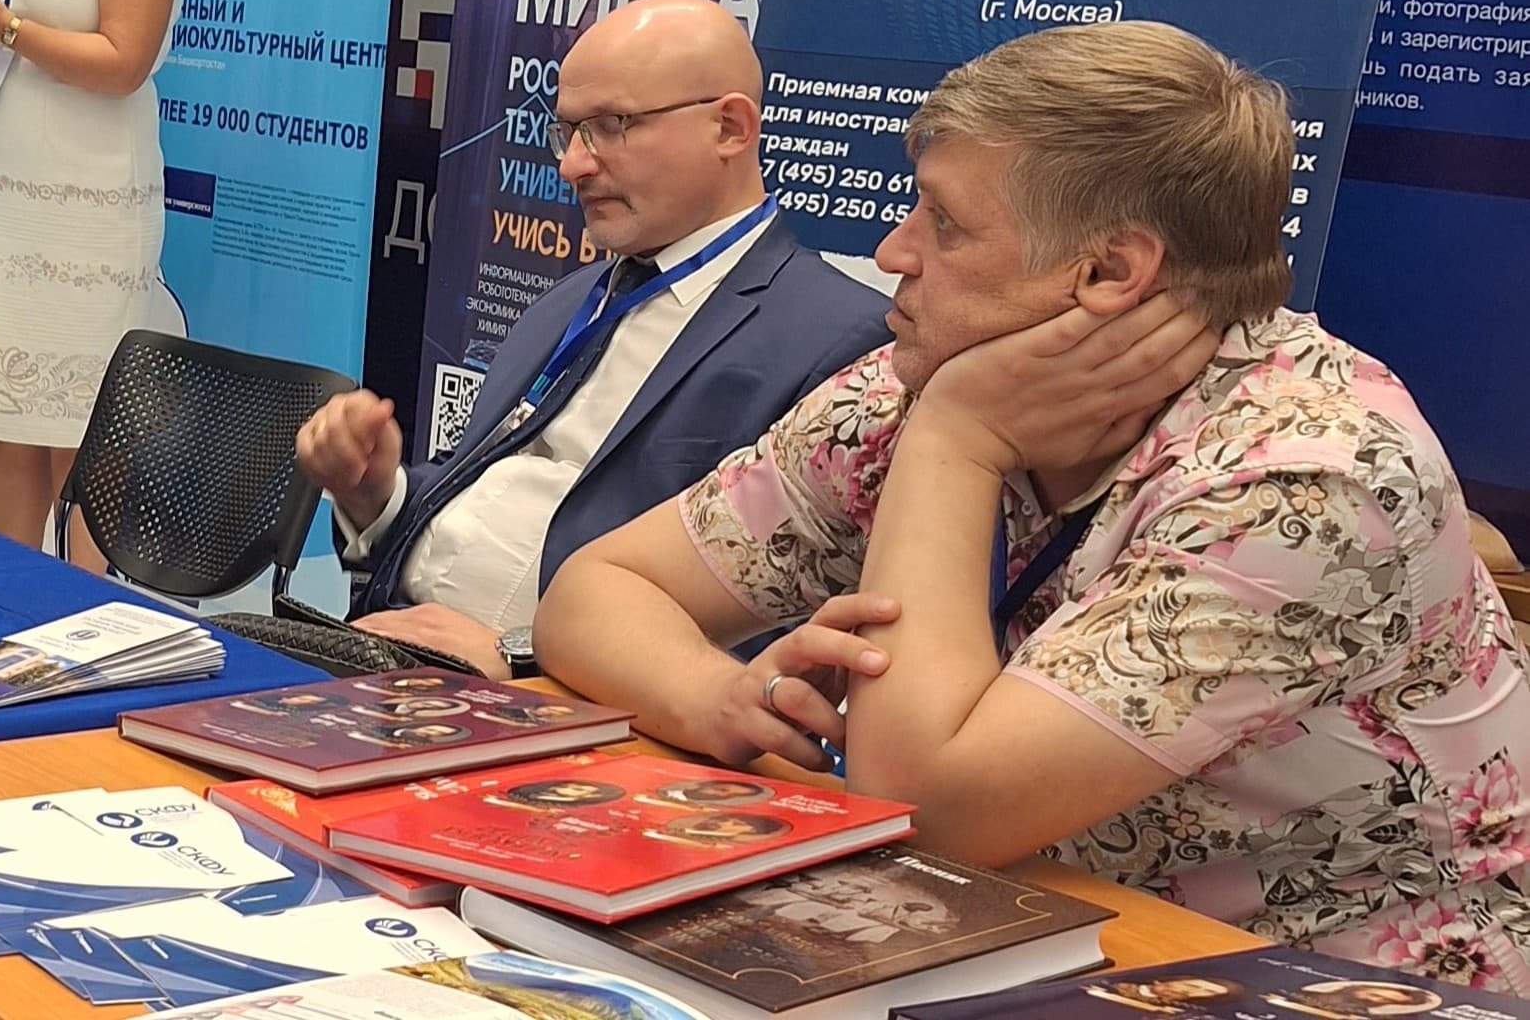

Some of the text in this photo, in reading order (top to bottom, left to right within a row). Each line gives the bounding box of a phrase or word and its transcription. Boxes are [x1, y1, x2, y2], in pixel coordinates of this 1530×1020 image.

[232, 0, 245, 24] И
[1381, 31, 1393, 45] и
[1400, 62, 1481, 83] подать
[767, 72, 881, 102] Приемная
[191, 103, 213, 126] 19
[219, 106, 250, 132] 000
[255, 111, 369, 150] СТУДЕНТОВ
[760, 105, 802, 123] для
[760, 134, 849, 157] граждан
[499, 157, 579, 206] УНИВЕ
[778, 160, 835, 188] (495)
[839, 169, 883, 192] 250
[774, 188, 829, 217] (495)
[832, 197, 876, 221] 250
[492, 209, 571, 259] УЧИСЬ
[466, 296, 521, 321] ЭКОНОМИКА
[477, 318, 507, 338] ХИМИЯ
